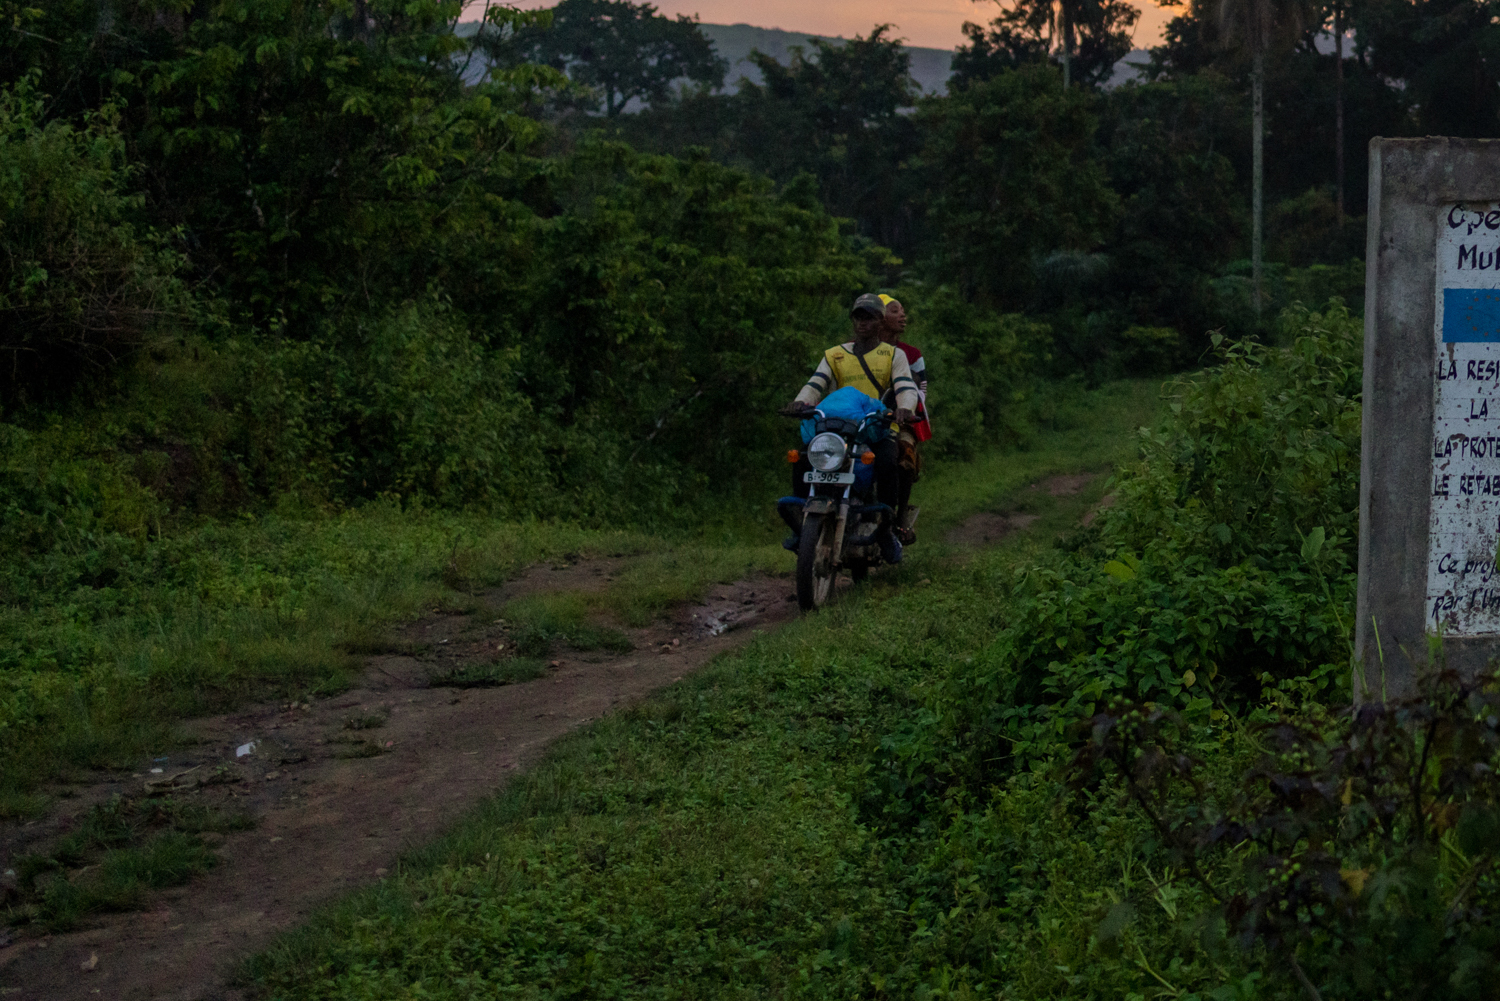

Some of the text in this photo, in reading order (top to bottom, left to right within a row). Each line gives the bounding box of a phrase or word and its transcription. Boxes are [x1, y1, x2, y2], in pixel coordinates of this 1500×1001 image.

[1438, 360, 1458, 381] LA
[1470, 399, 1488, 420] LA
[1434, 438, 1452, 458] LA
[1434, 475, 1450, 496] LE
[1438, 553, 1458, 574] Ce
[1431, 595, 1463, 619] par
